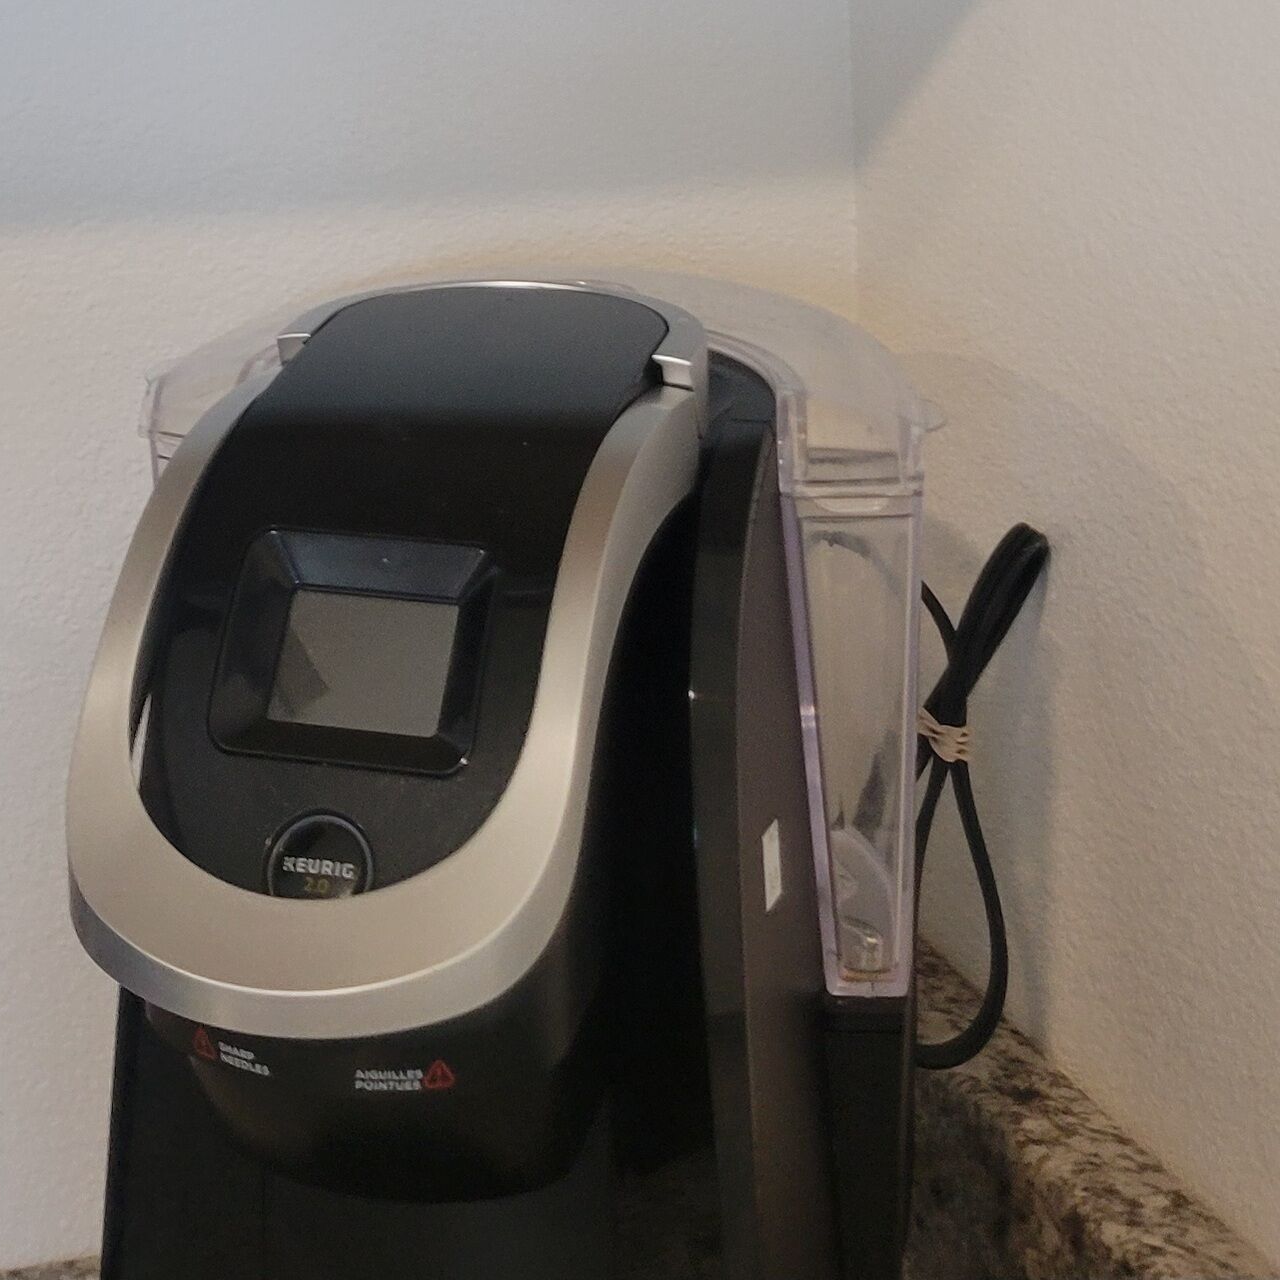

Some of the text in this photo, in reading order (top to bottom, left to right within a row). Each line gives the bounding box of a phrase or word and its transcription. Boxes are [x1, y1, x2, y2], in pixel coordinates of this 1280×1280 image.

[282, 855, 356, 880] KEURIG
[219, 1053, 271, 1076] NEEDLES
[355, 1068, 423, 1080] AIGUILLES
[355, 1080, 422, 1091] POINTUES
